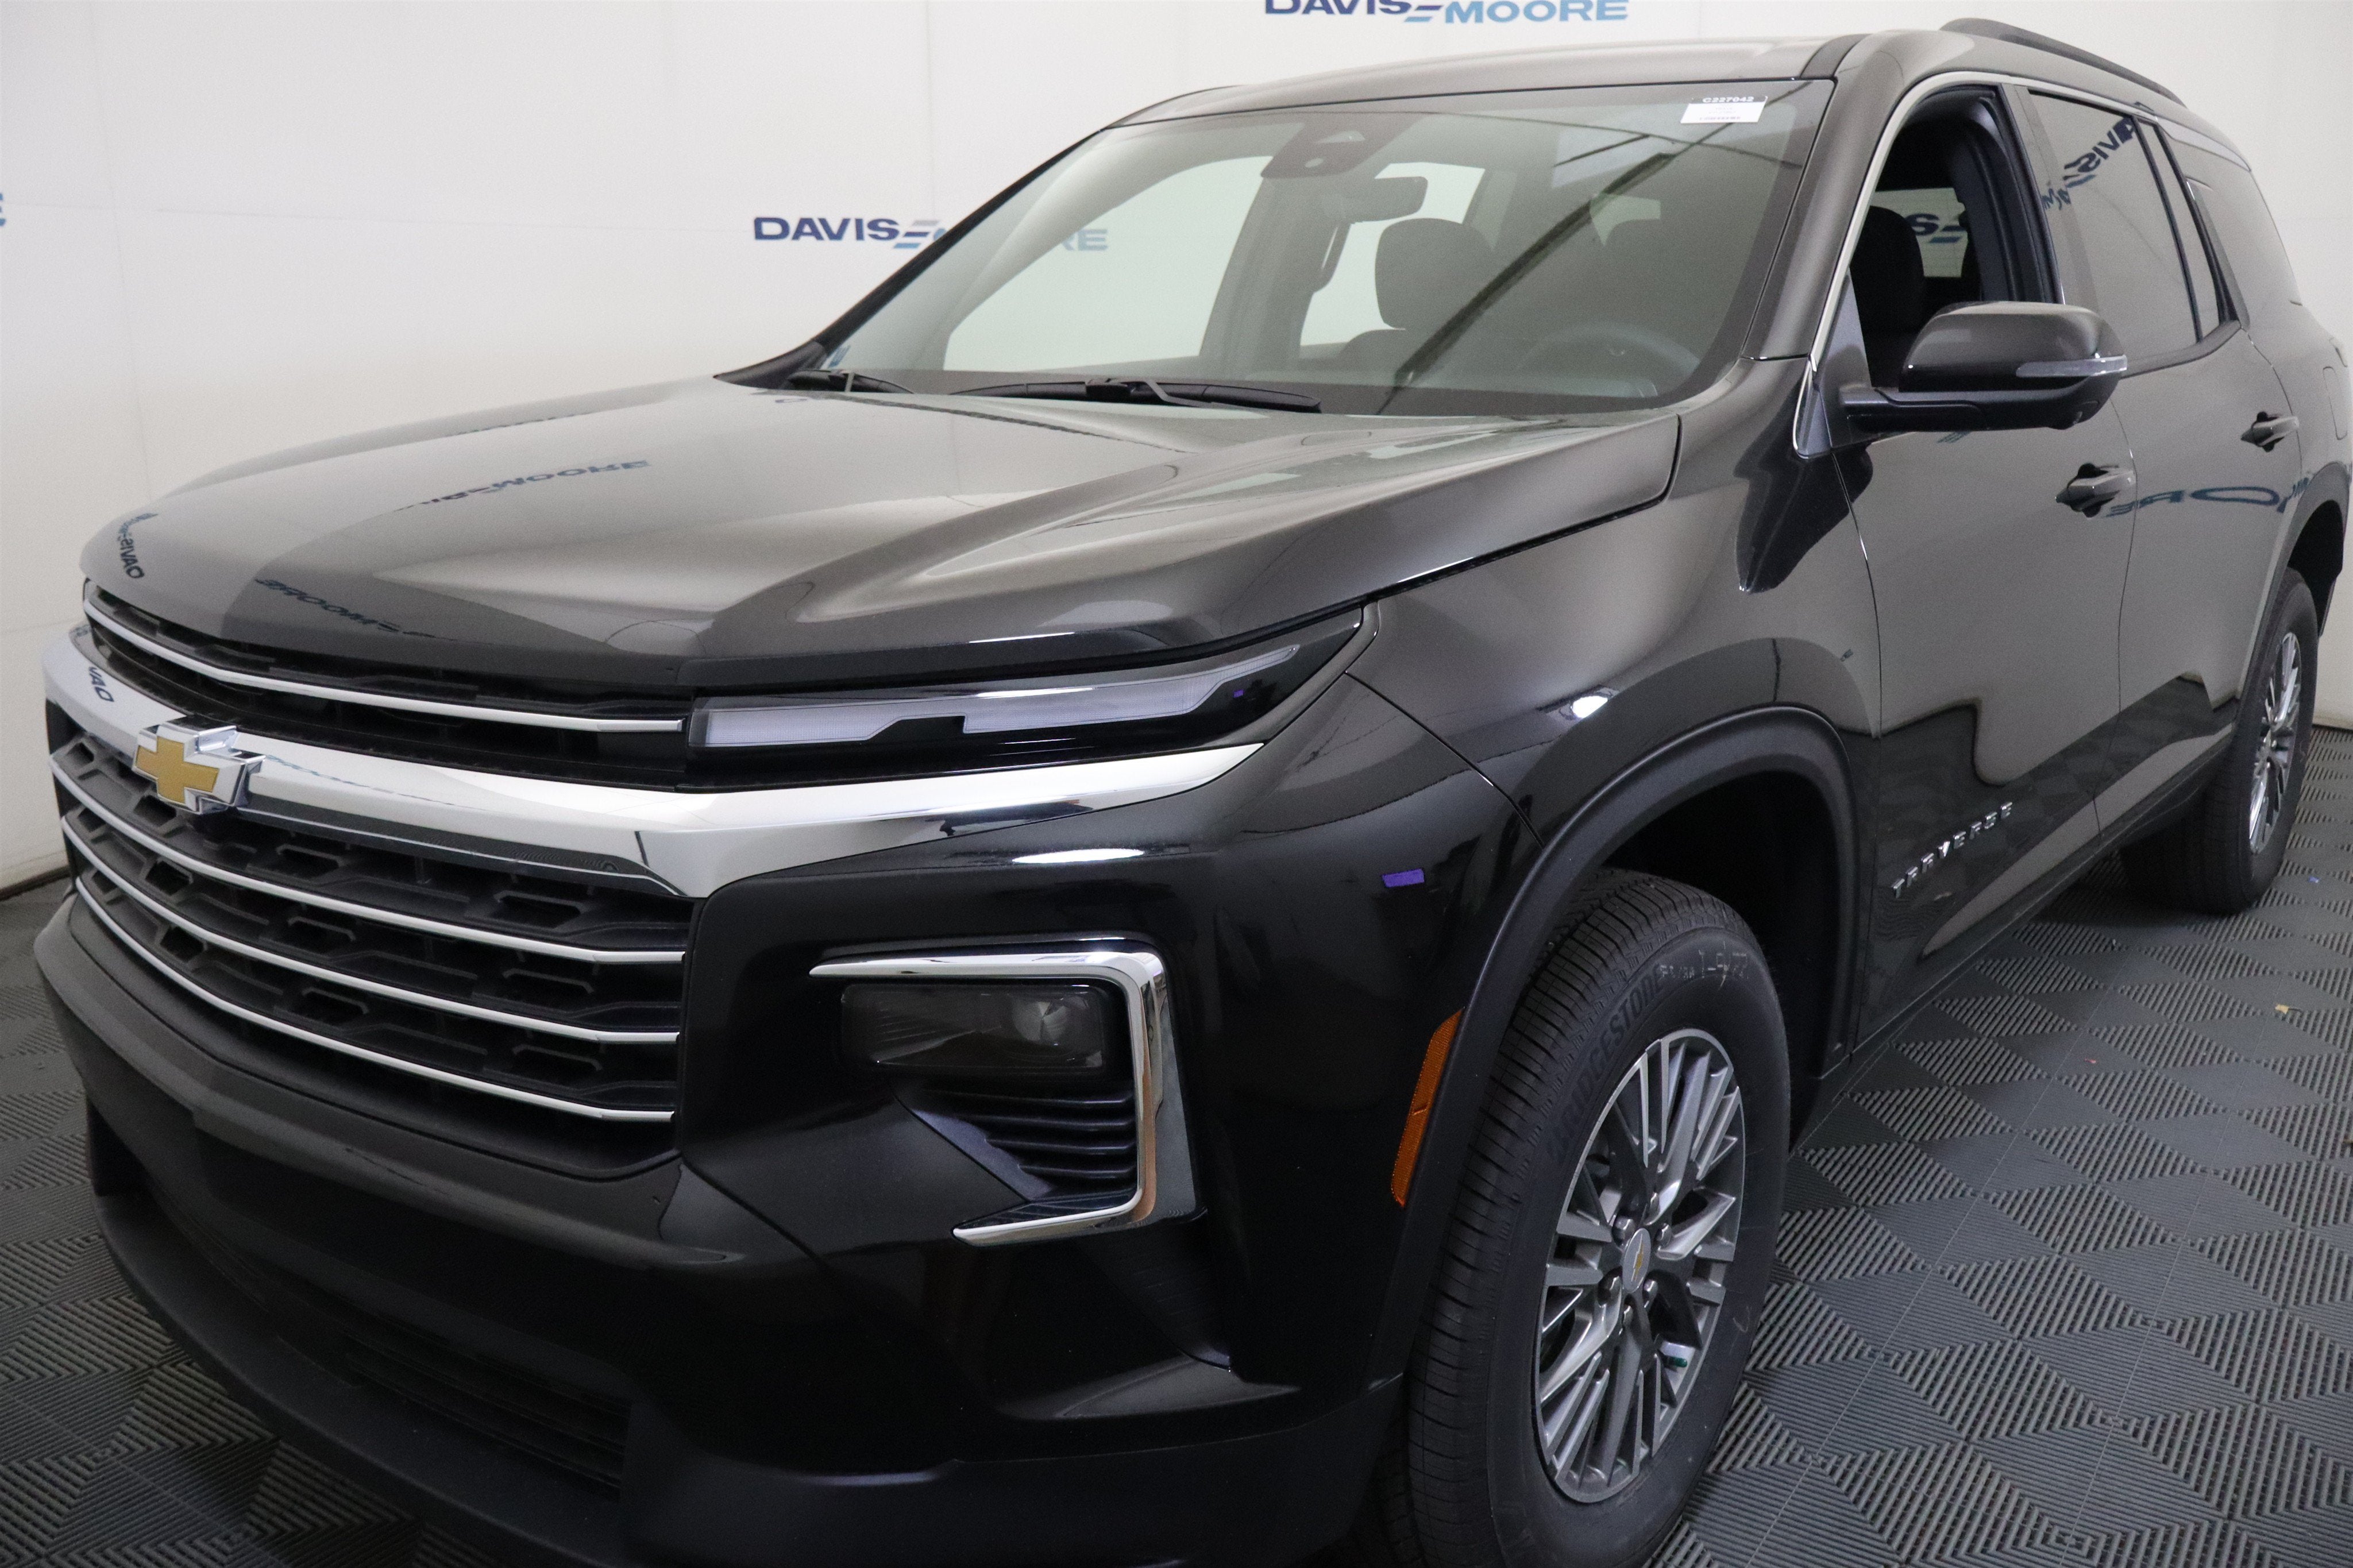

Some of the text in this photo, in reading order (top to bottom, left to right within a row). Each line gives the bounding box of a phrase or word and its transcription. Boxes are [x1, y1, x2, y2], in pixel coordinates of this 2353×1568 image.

[1265, 0, 1629, 24] DAVIS MOORE
[753, 217, 900, 241] DAVIS
